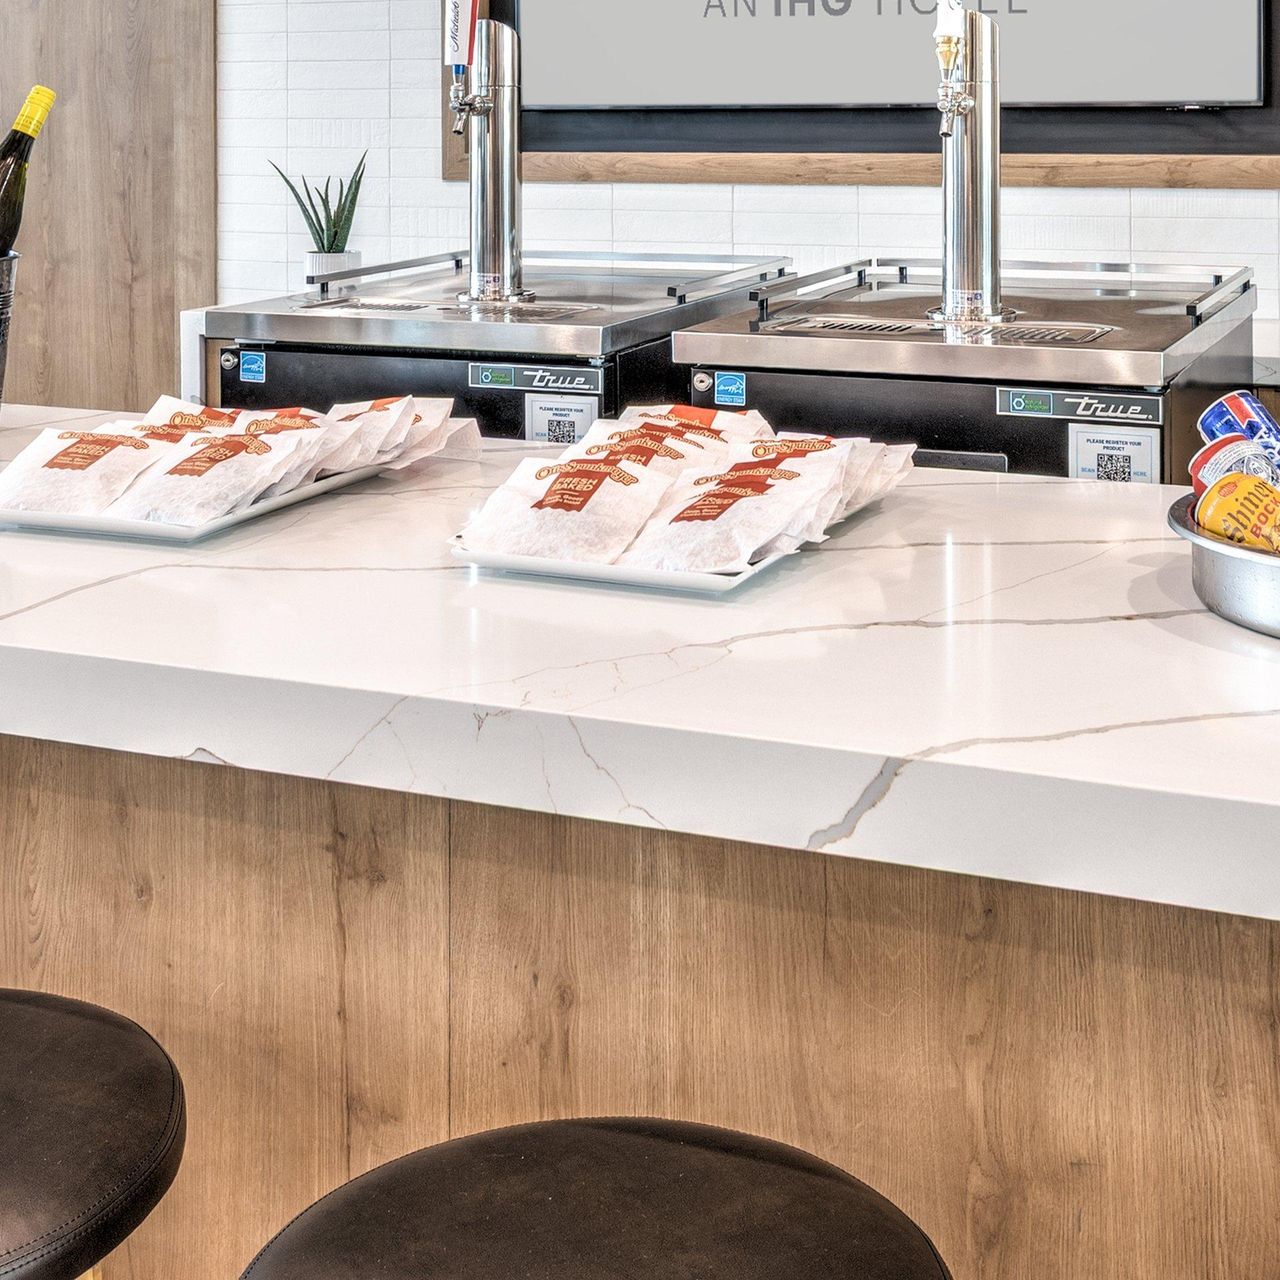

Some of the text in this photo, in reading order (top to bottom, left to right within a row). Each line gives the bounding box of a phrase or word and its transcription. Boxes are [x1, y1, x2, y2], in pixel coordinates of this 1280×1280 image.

[523, 370, 591, 390] true
[1064, 397, 1148, 419] true
[551, 483, 594, 492] BAKED
[556, 477, 598, 486] FRESH
[1222, 480, 1274, 543] Shiner
